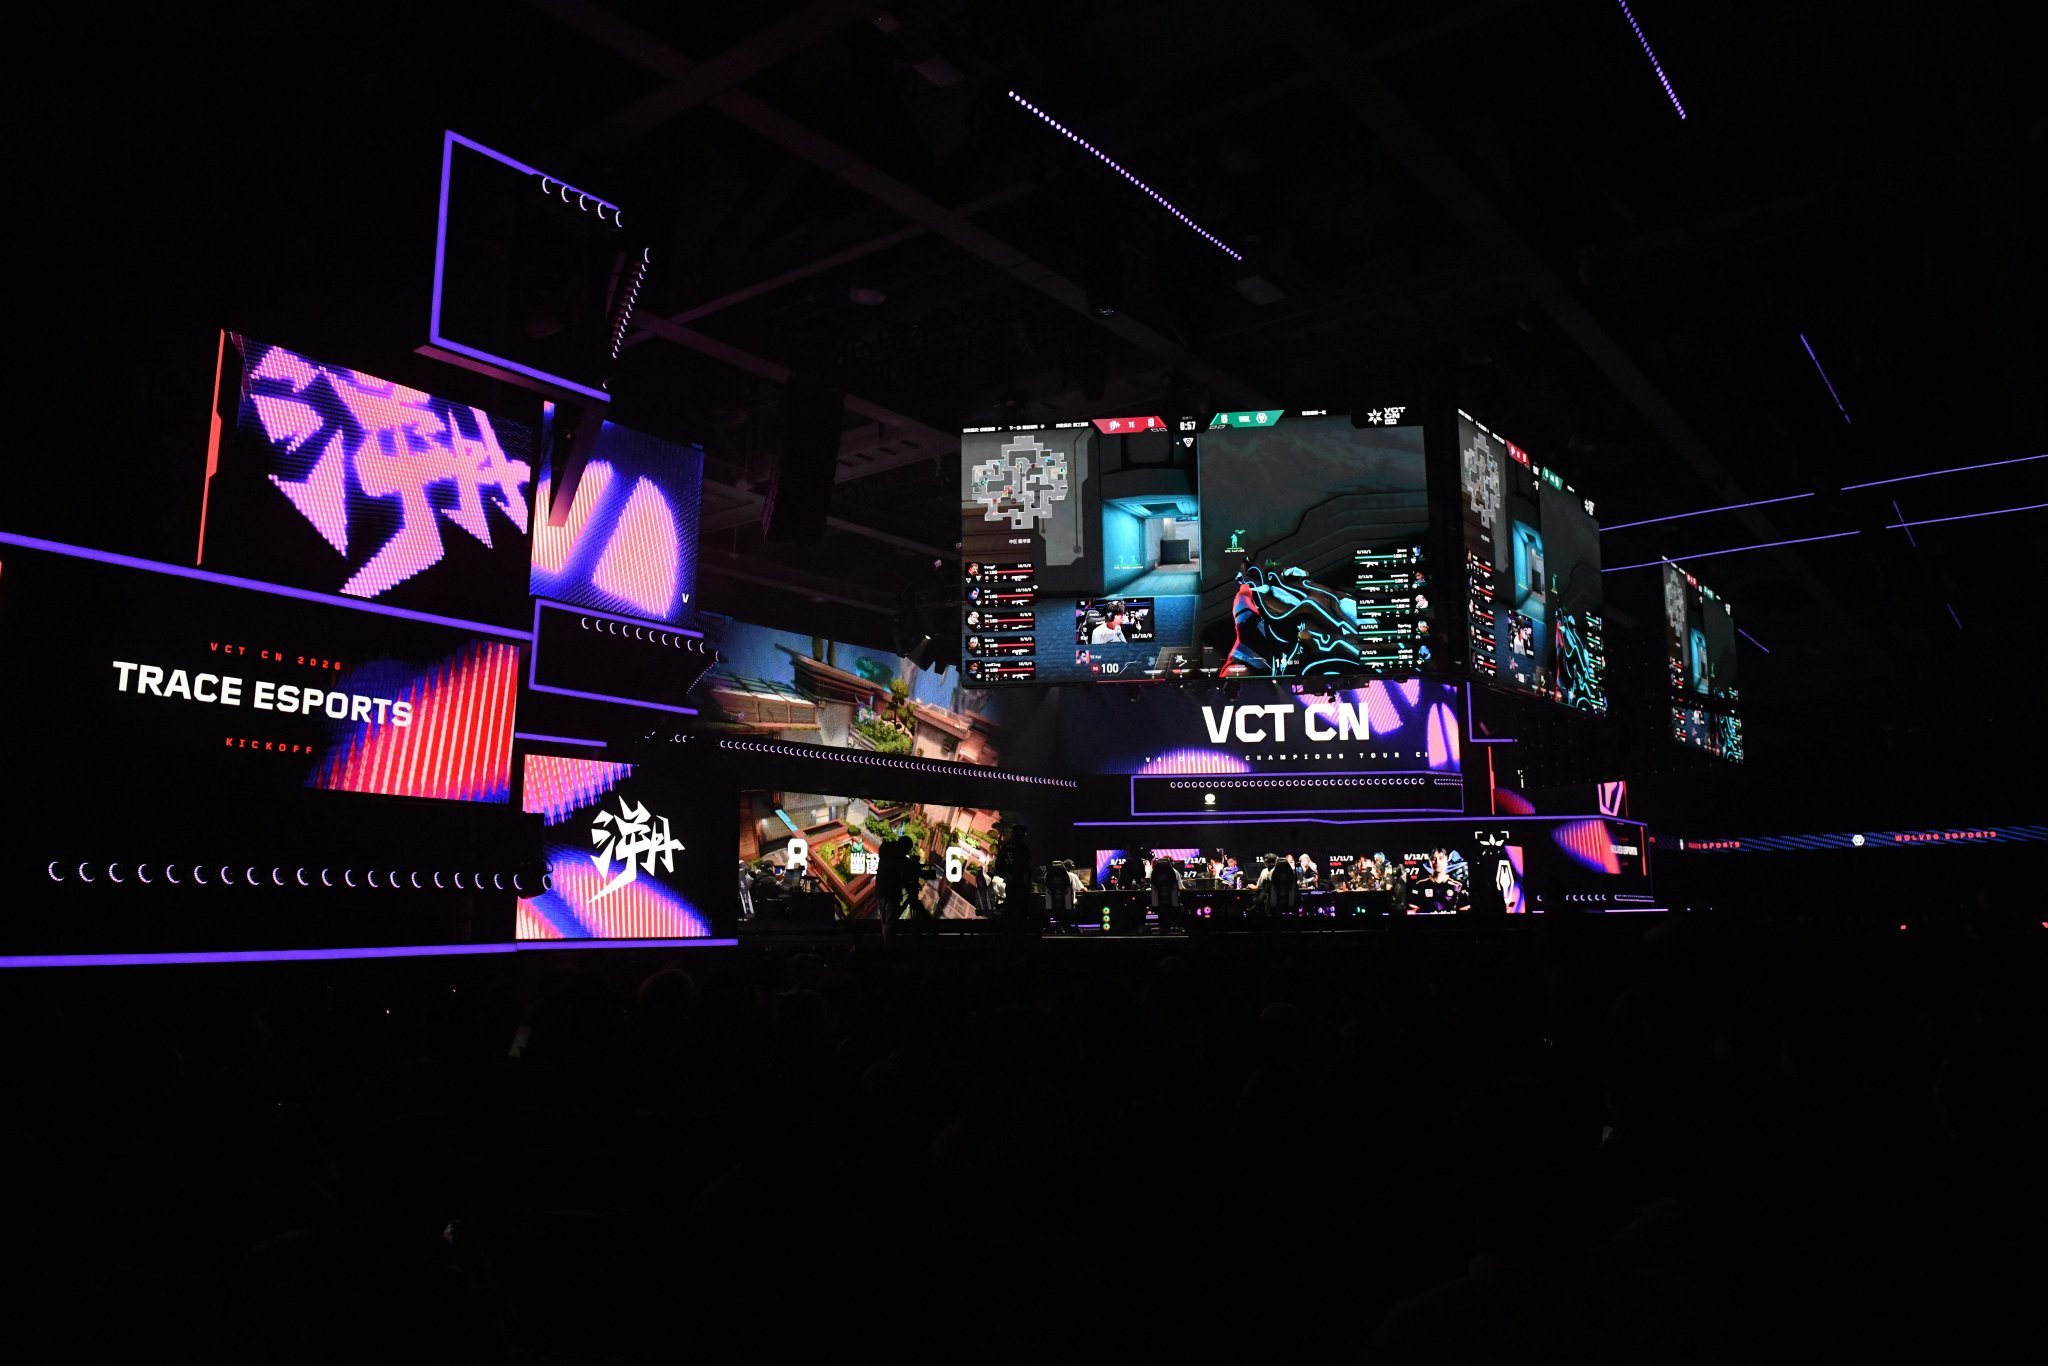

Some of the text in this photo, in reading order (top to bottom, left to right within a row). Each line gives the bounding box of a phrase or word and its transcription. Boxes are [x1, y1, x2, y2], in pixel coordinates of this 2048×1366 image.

[1180, 421, 1196, 431] 0:57
[1221, 414, 1228, 424] 6
[682, 593, 690, 603] V
[210, 642, 342, 671] VCT CN 2026
[1101, 663, 1119, 674] 100
[112, 660, 413, 728] TRACE ESPORTS
[1201, 702, 1371, 743] VCT CN
[225, 737, 313, 754] KICKOFF
[1245, 753, 1344, 761] CHAMPIONS
[1895, 831, 1997, 842] WOLVES ESPORTS
[788, 838, 808, 876] 8
[946, 846, 962, 882] 6
